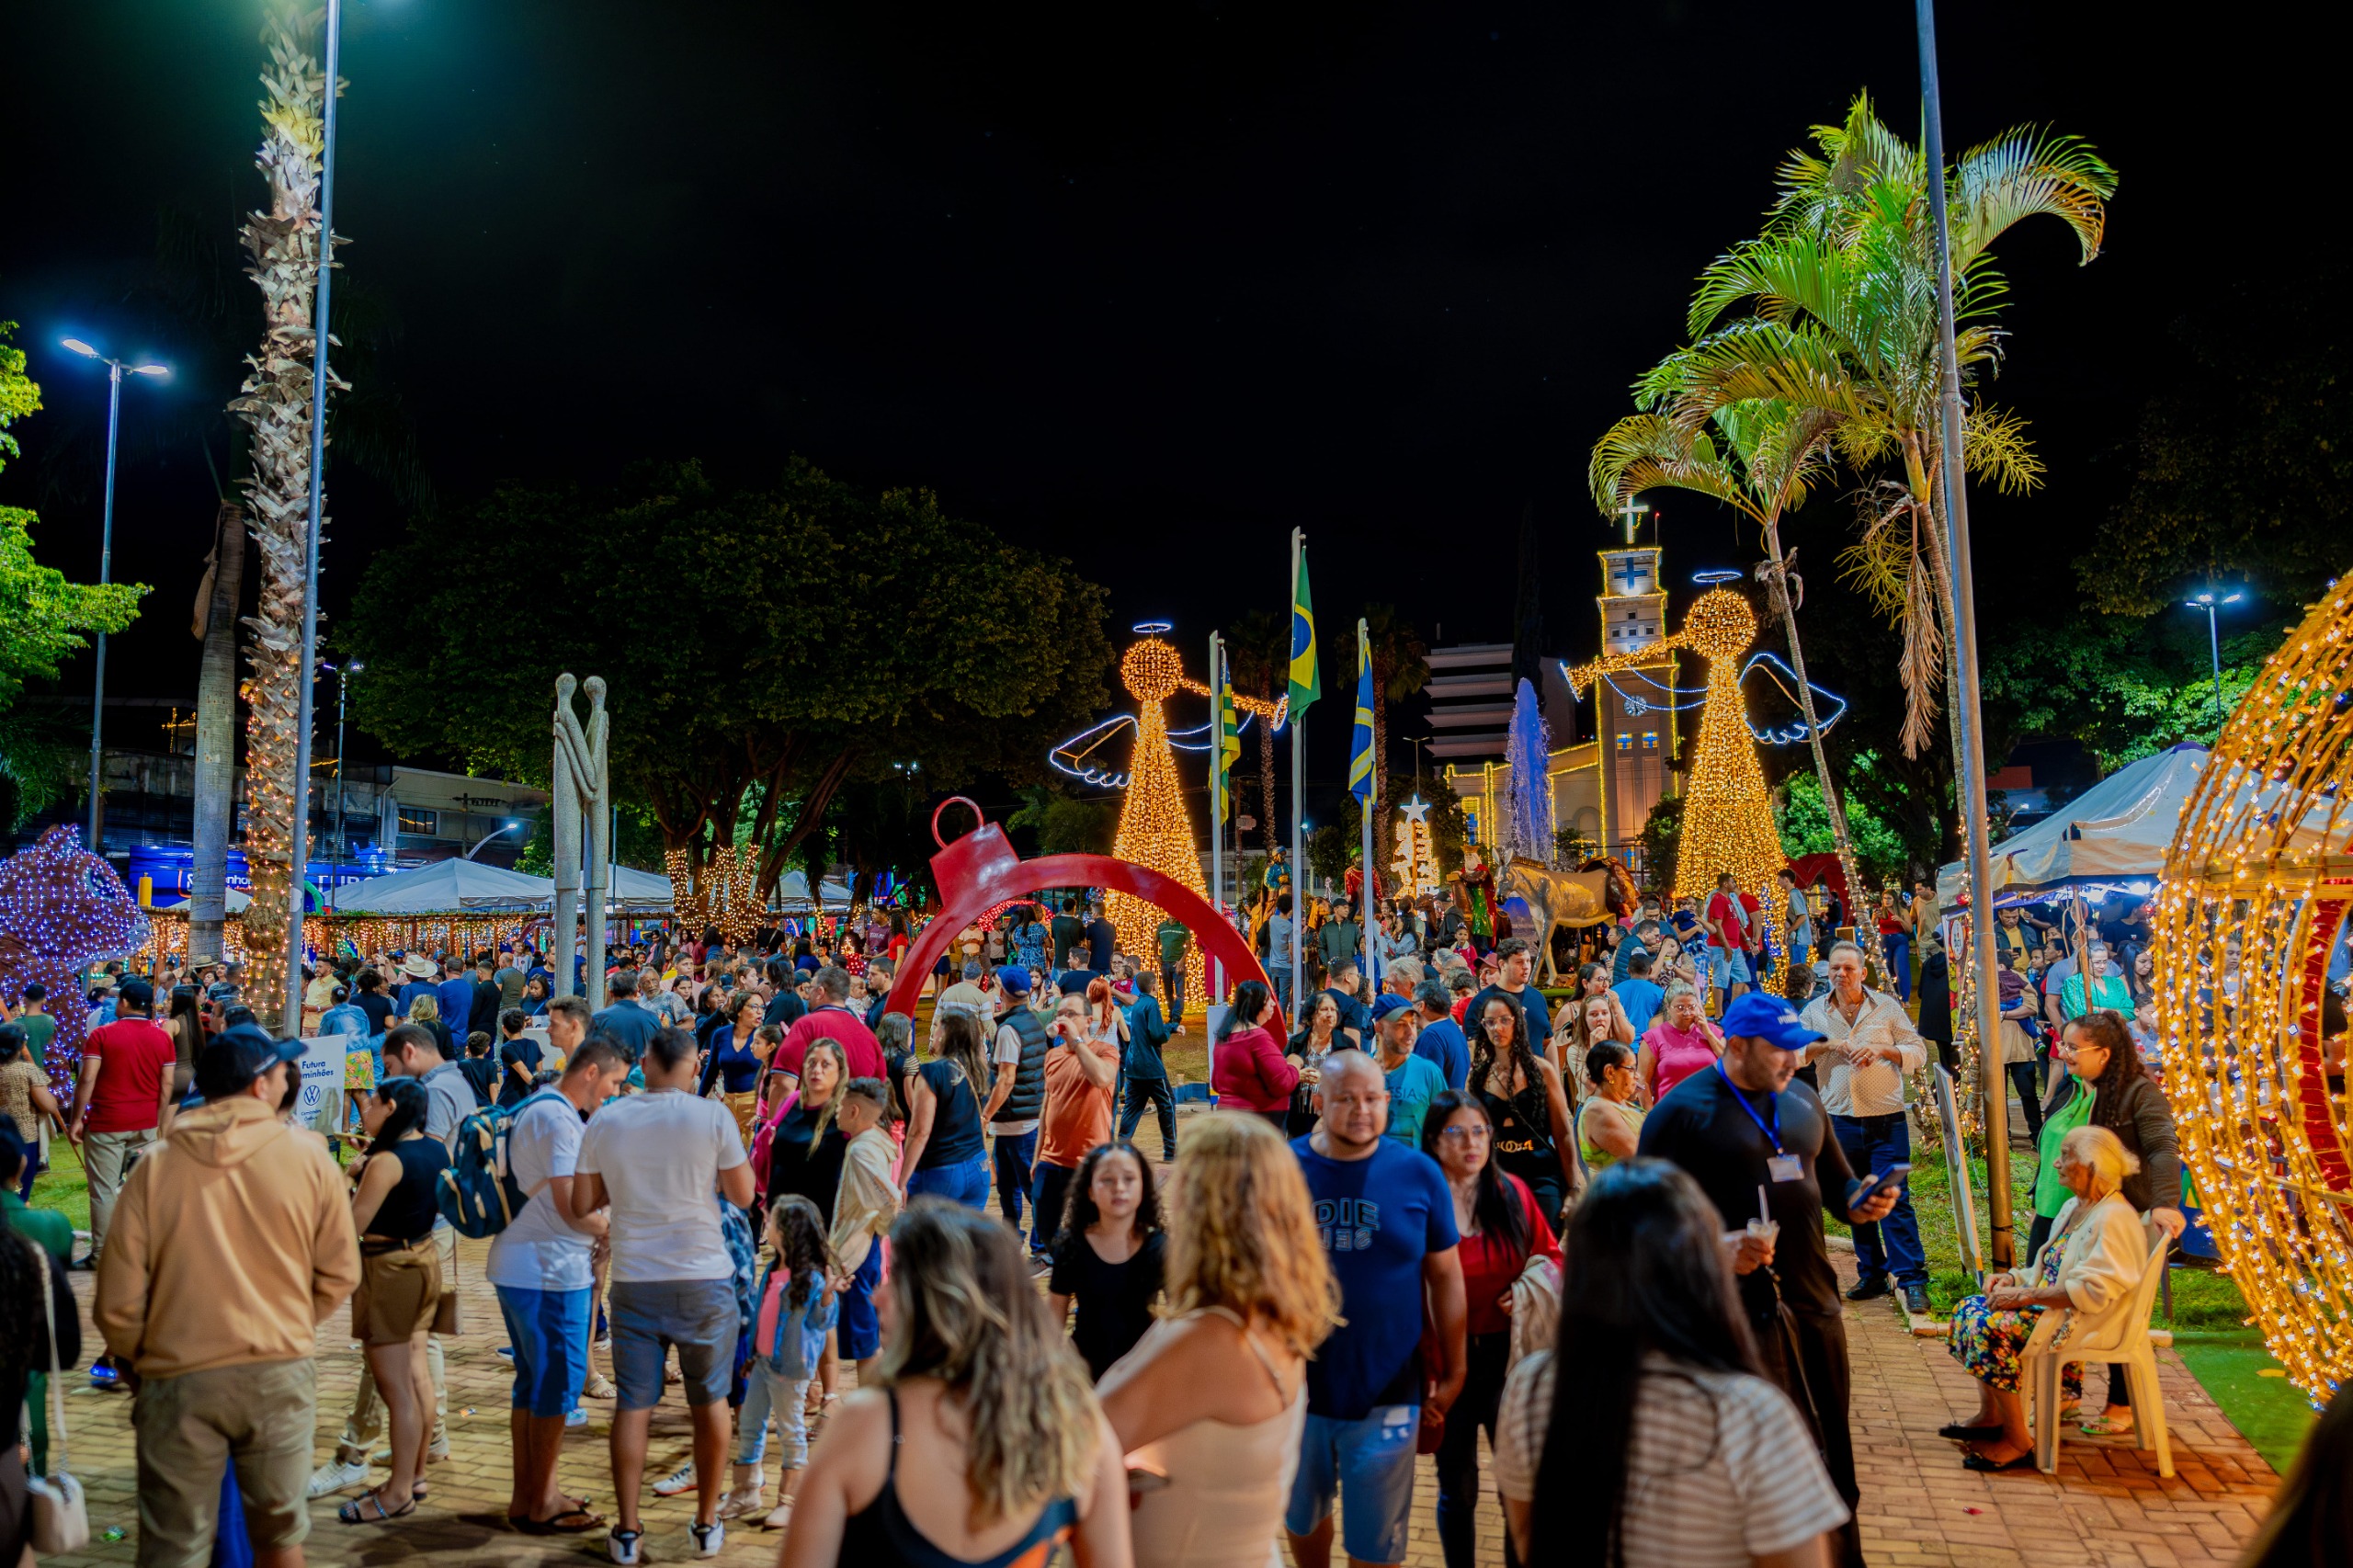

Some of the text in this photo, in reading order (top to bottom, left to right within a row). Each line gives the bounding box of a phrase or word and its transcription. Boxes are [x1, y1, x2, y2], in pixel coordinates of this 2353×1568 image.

[301, 1061, 325, 1069] Futura
[302, 1069, 334, 1079] minhões
[1388, 1086, 1416, 1099] ESIA
